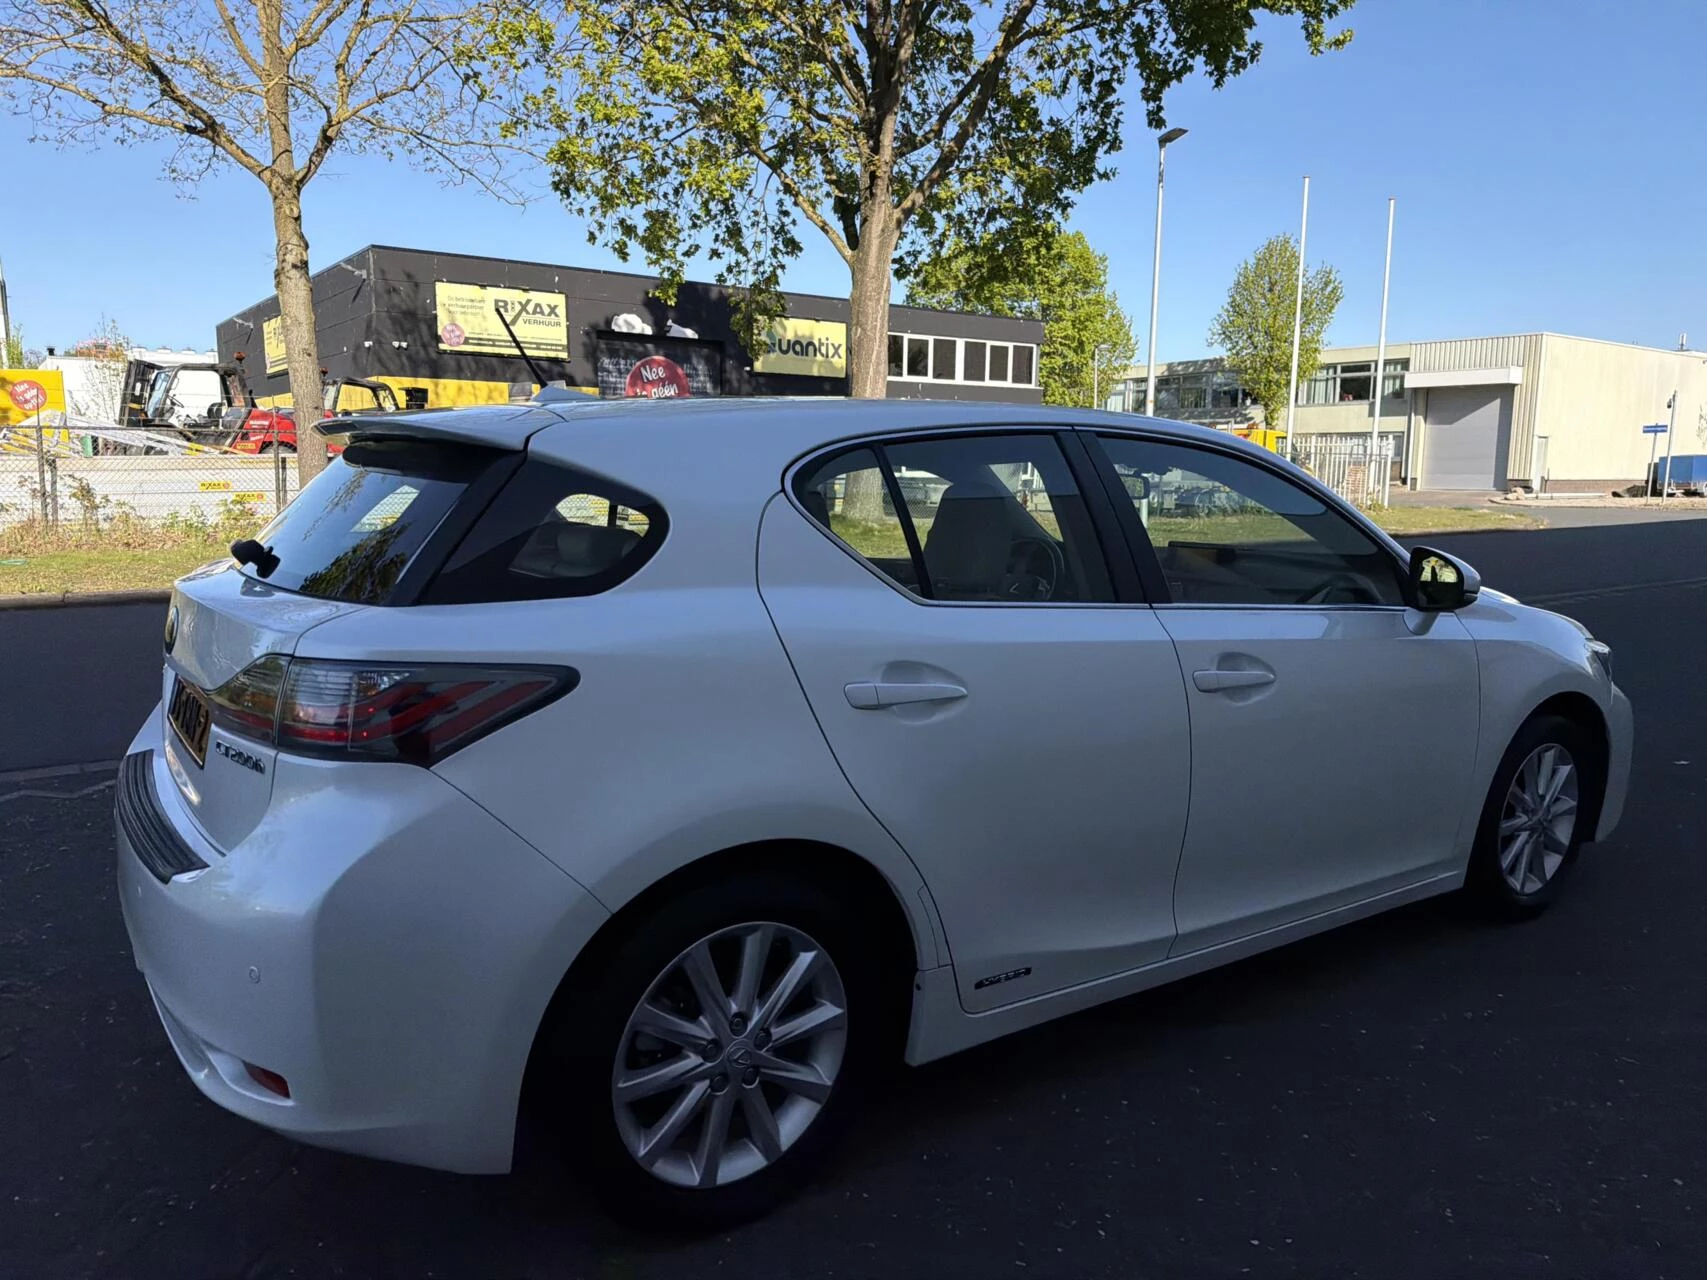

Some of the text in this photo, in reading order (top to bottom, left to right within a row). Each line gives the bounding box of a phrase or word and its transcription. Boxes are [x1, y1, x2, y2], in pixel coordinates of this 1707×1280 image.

[522, 317, 561, 328] VERHUUR
[641, 365, 665, 383] Nee
[216, 740, 266, 775] CT200h
